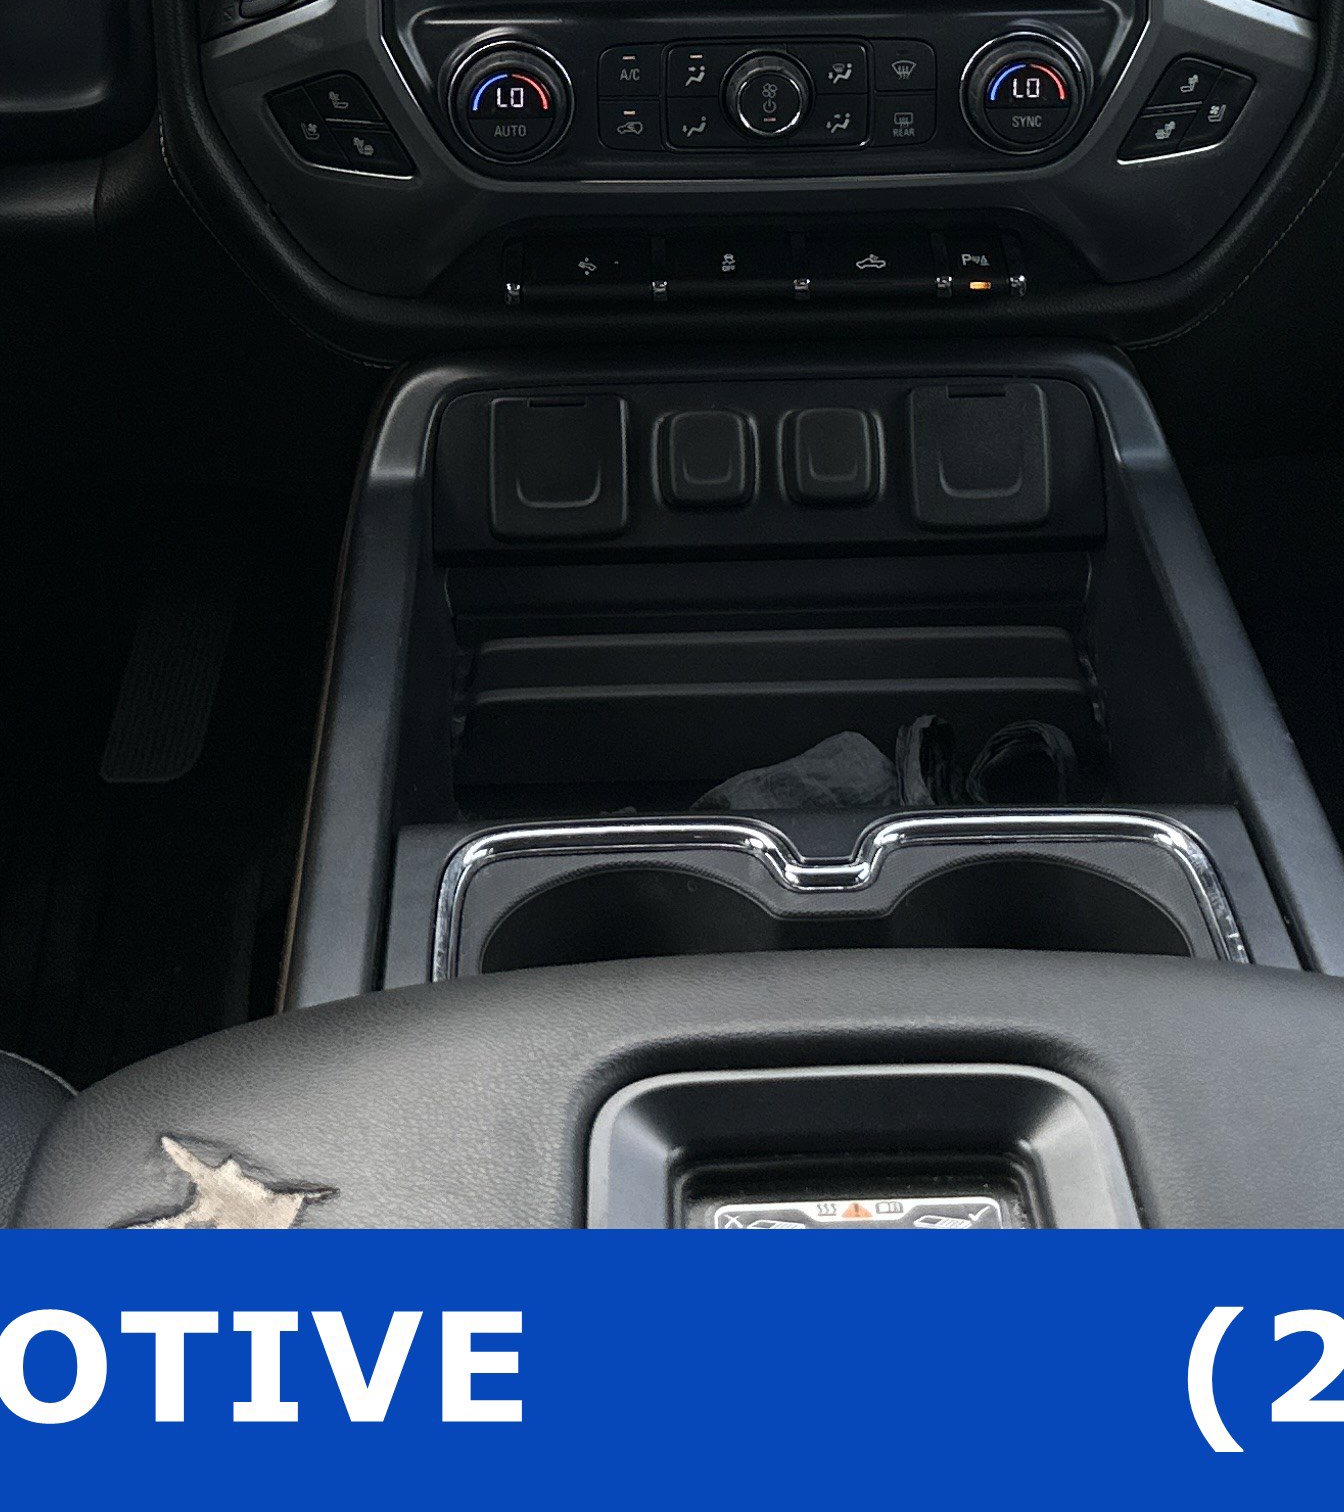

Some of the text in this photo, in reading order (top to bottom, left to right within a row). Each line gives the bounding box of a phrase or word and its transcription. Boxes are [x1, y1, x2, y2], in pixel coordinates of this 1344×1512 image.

[620, 68, 641, 81] A/C
[1013, 77, 1040, 98] LO
[497, 87, 524, 108] LO
[1012, 115, 1043, 128] SYNC
[494, 124, 527, 137] AUTO
[893, 127, 916, 137] REAR
